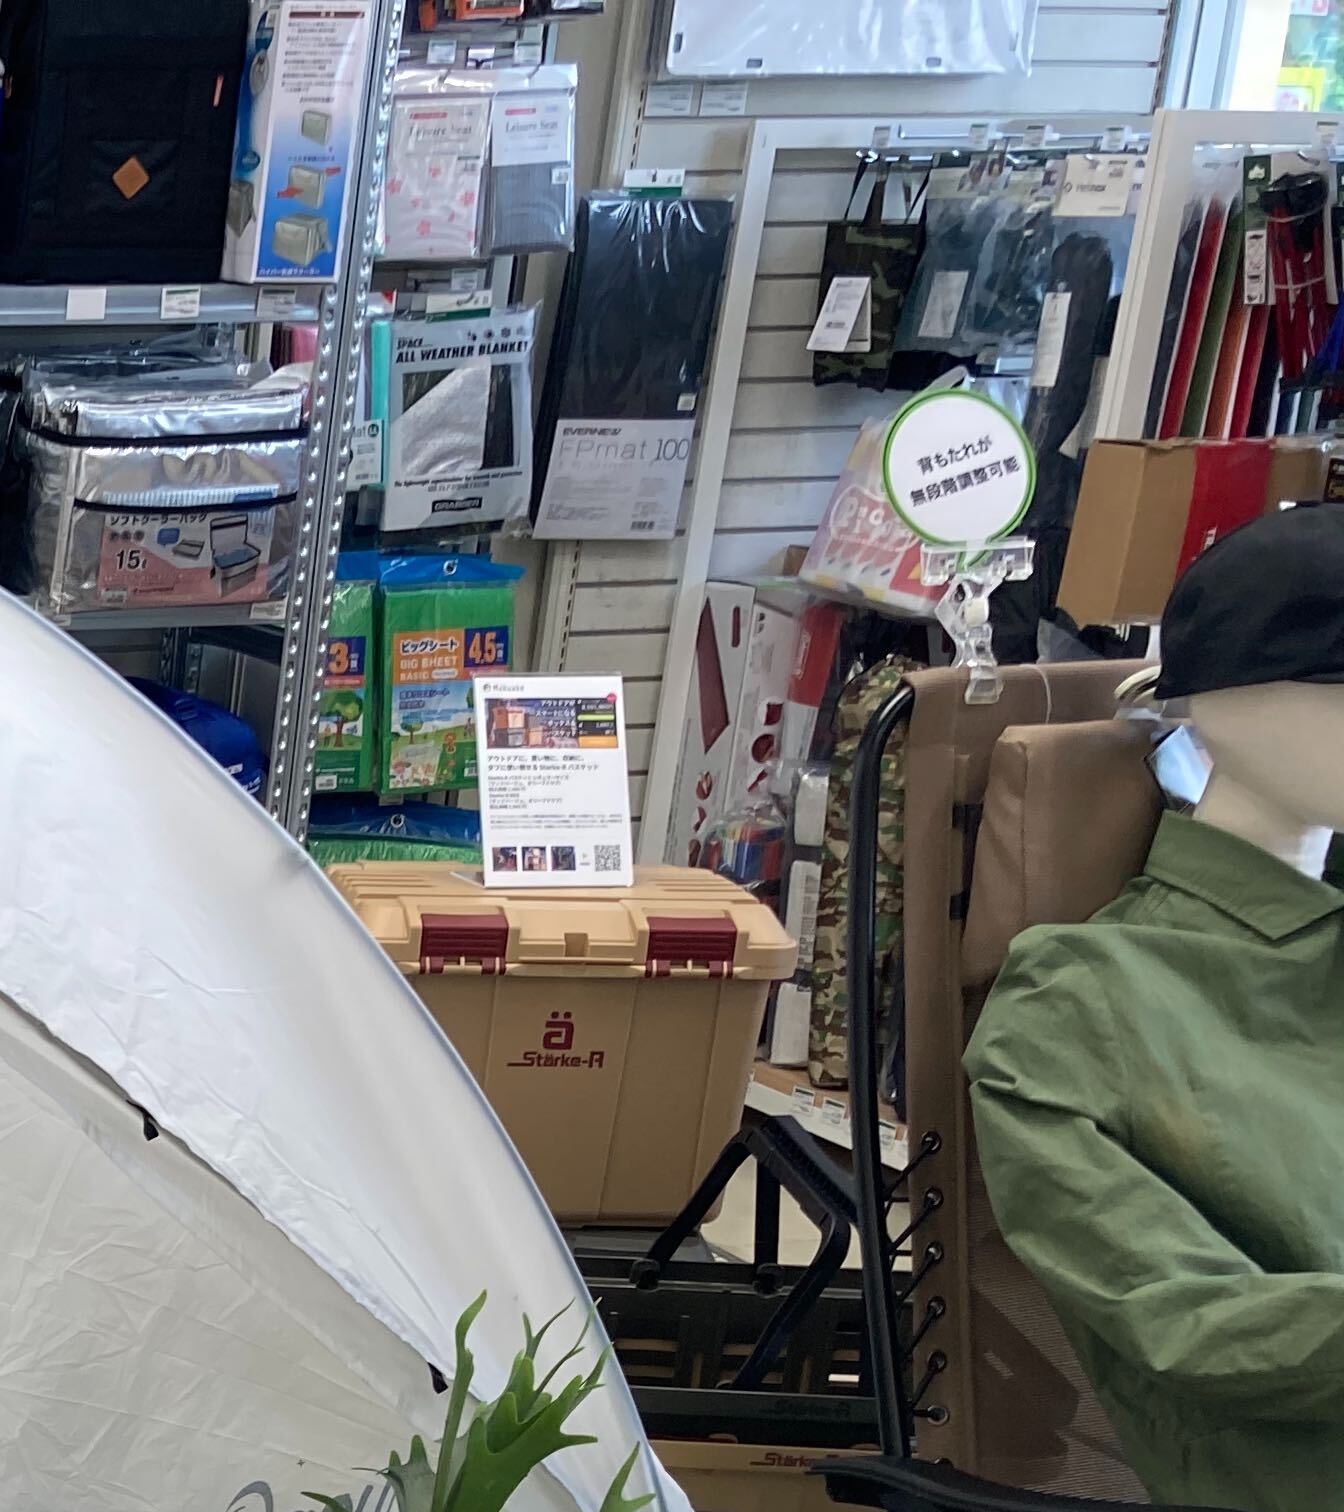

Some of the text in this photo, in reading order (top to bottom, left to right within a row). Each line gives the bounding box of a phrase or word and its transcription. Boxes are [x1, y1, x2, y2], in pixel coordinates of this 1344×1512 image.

[396, 351, 415, 363] ALL
[421, 346, 475, 361] WEATHER
[654, 439, 690, 461] 100
[917, 435, 993, 475] 背もたれが
[910, 456, 1021, 507] 無段階調整可能
[400, 639, 459, 654] ビッグシート
